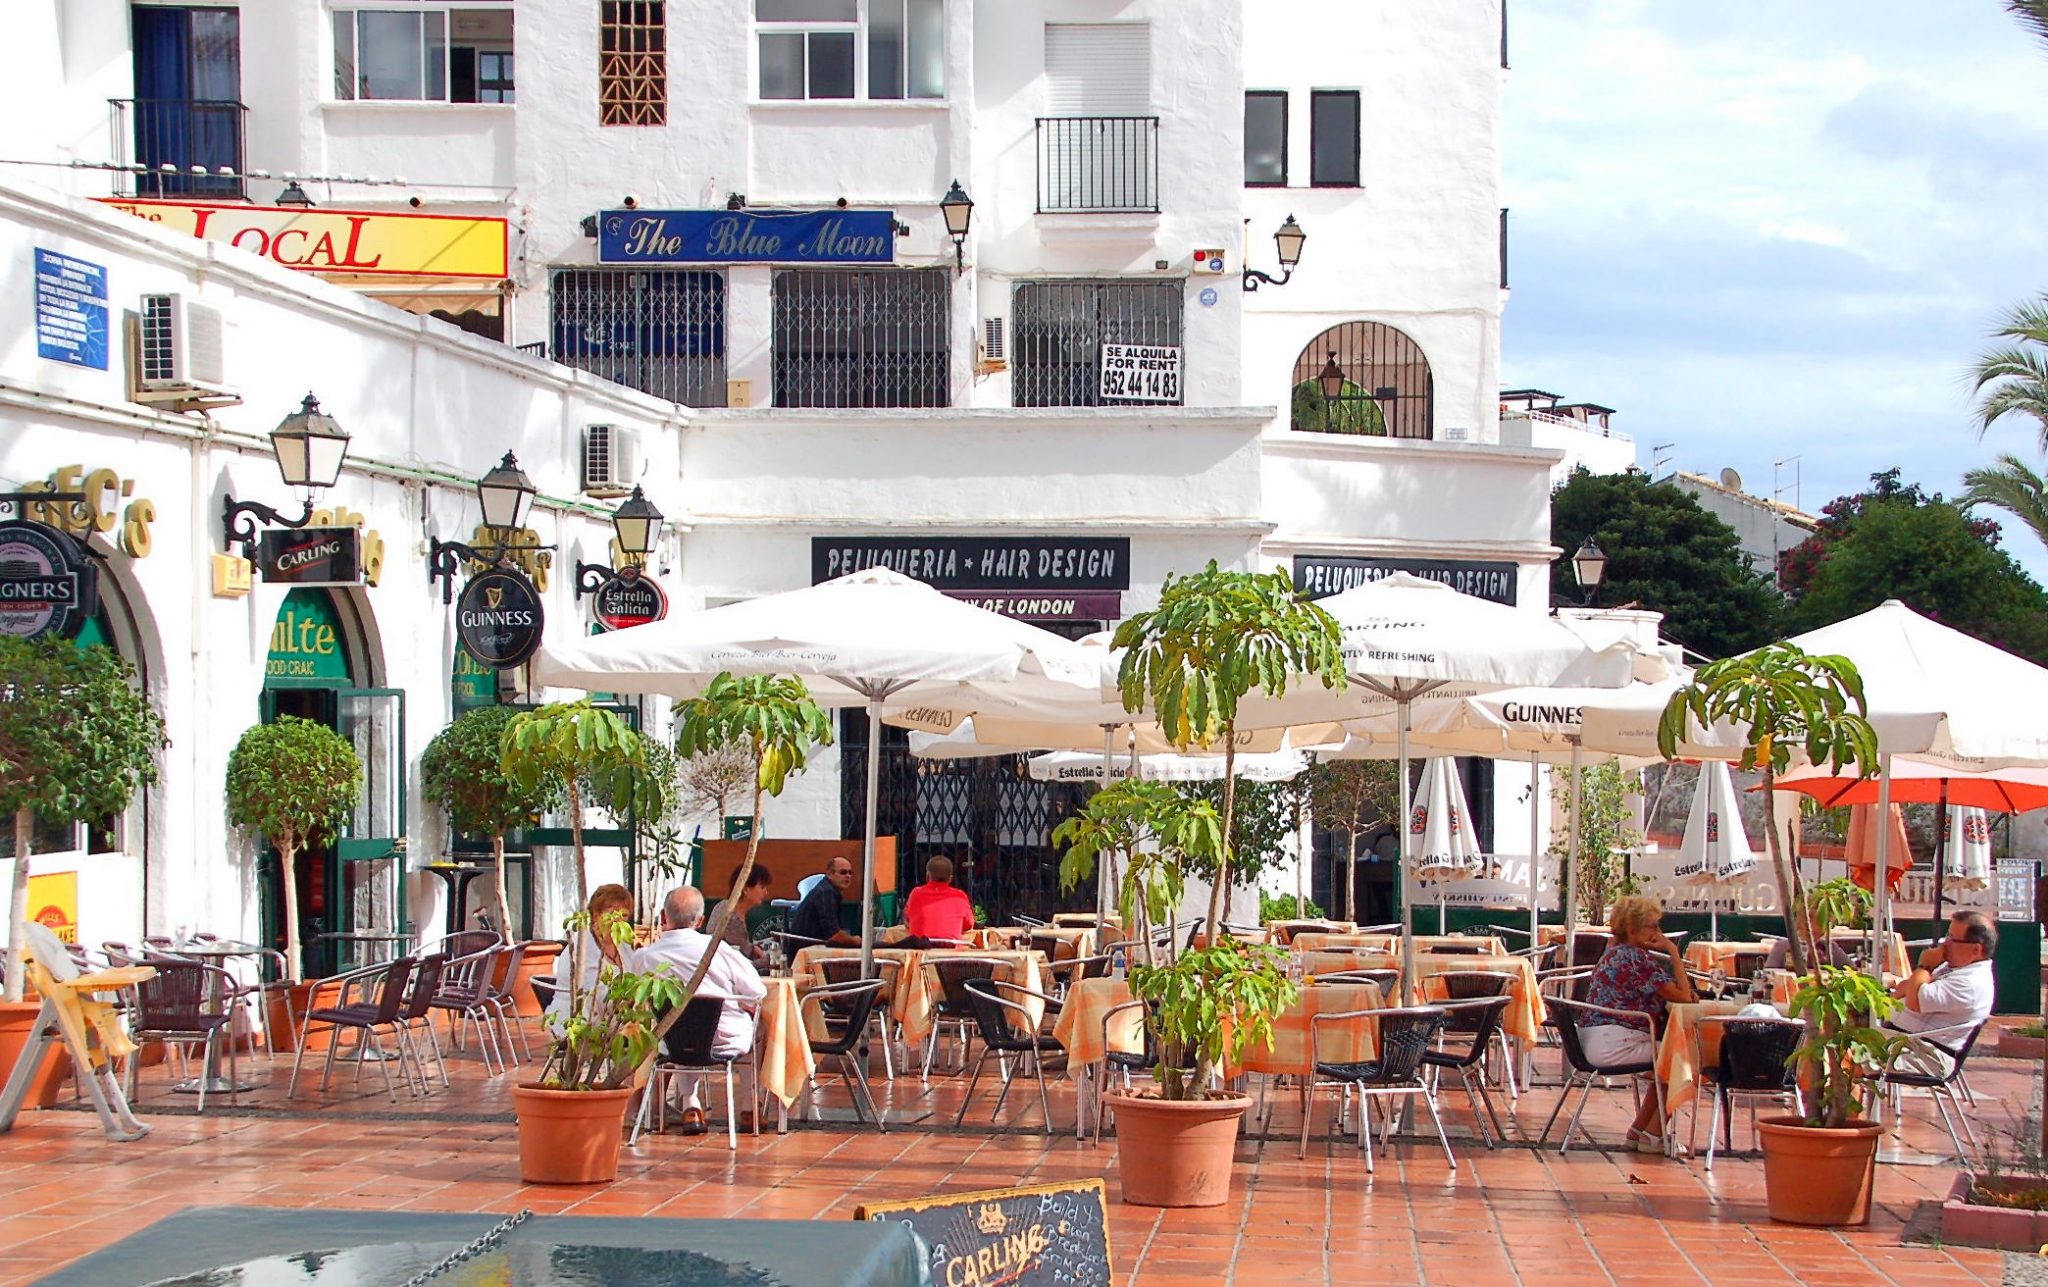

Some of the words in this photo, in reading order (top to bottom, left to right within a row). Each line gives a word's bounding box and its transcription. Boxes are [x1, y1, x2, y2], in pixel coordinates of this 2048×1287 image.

[192, 209, 382, 267] LOCAL
[624, 218, 681, 256] The
[706, 217, 782, 256] Blue
[799, 218, 886, 257] Moon
[1107, 346, 1122, 357] SE
[1125, 348, 1178, 360] ALQUILA
[1106, 358, 1134, 370] FOR
[1139, 360, 1177, 371] RENT
[1103, 370, 1125, 395] 952
[1128, 371, 1143, 396] 44
[1146, 372, 1160, 397] 14
[1163, 373, 1177, 398] 83
[277, 540, 340, 571] CARLING
[828, 548, 957, 578] PELUQUERIA
[980, 548, 1032, 579] HAIR
[1038, 548, 1115, 578] DESIGN
[0, 581, 70, 599] GNERS
[1456, 570, 1509, 598] DESIGN
[606, 589, 652, 602] Estrella
[607, 602, 649, 615] Galicia
[983, 599, 1005, 614] OF
[1007, 599, 1075, 615] LONDON
[462, 610, 532, 628] GUINNESS
[1368, 650, 1435, 663] REFRESHING
[267, 660, 287, 675] OOD
[1503, 702, 1582, 724] GUINNES
[1059, 766, 1095, 778] Estrella
[946, 1223, 1047, 1287] CARLING
